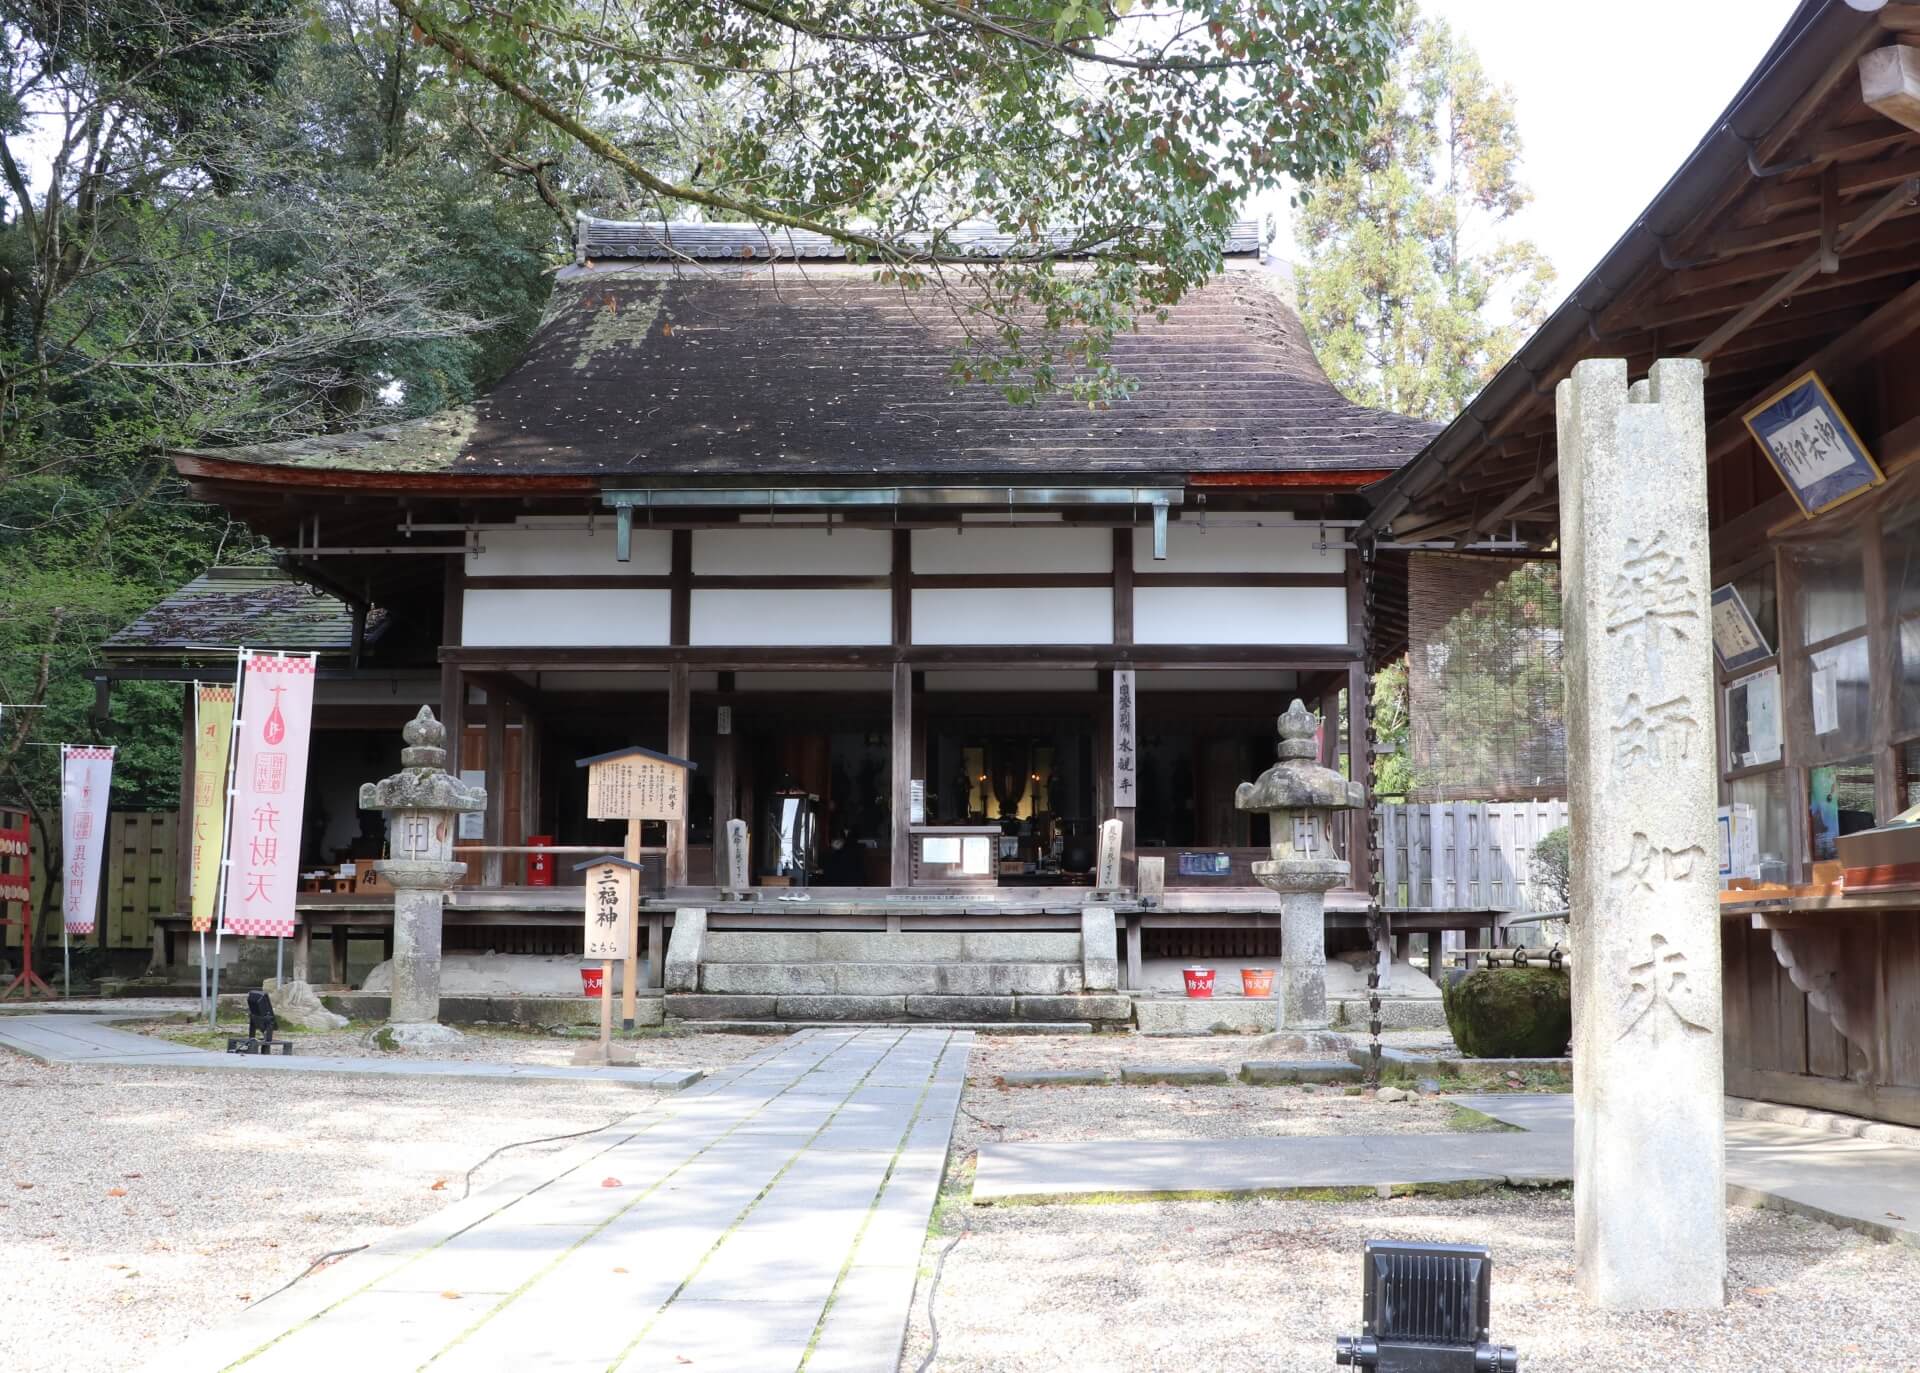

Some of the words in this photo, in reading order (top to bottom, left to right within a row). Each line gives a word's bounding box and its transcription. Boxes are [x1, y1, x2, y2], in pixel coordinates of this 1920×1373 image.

[595, 869, 619, 929] 三福神
[590, 942, 617, 953] こちら
[1188, 980, 1213, 990] 防火用
[1245, 979, 1270, 989] 防火用
